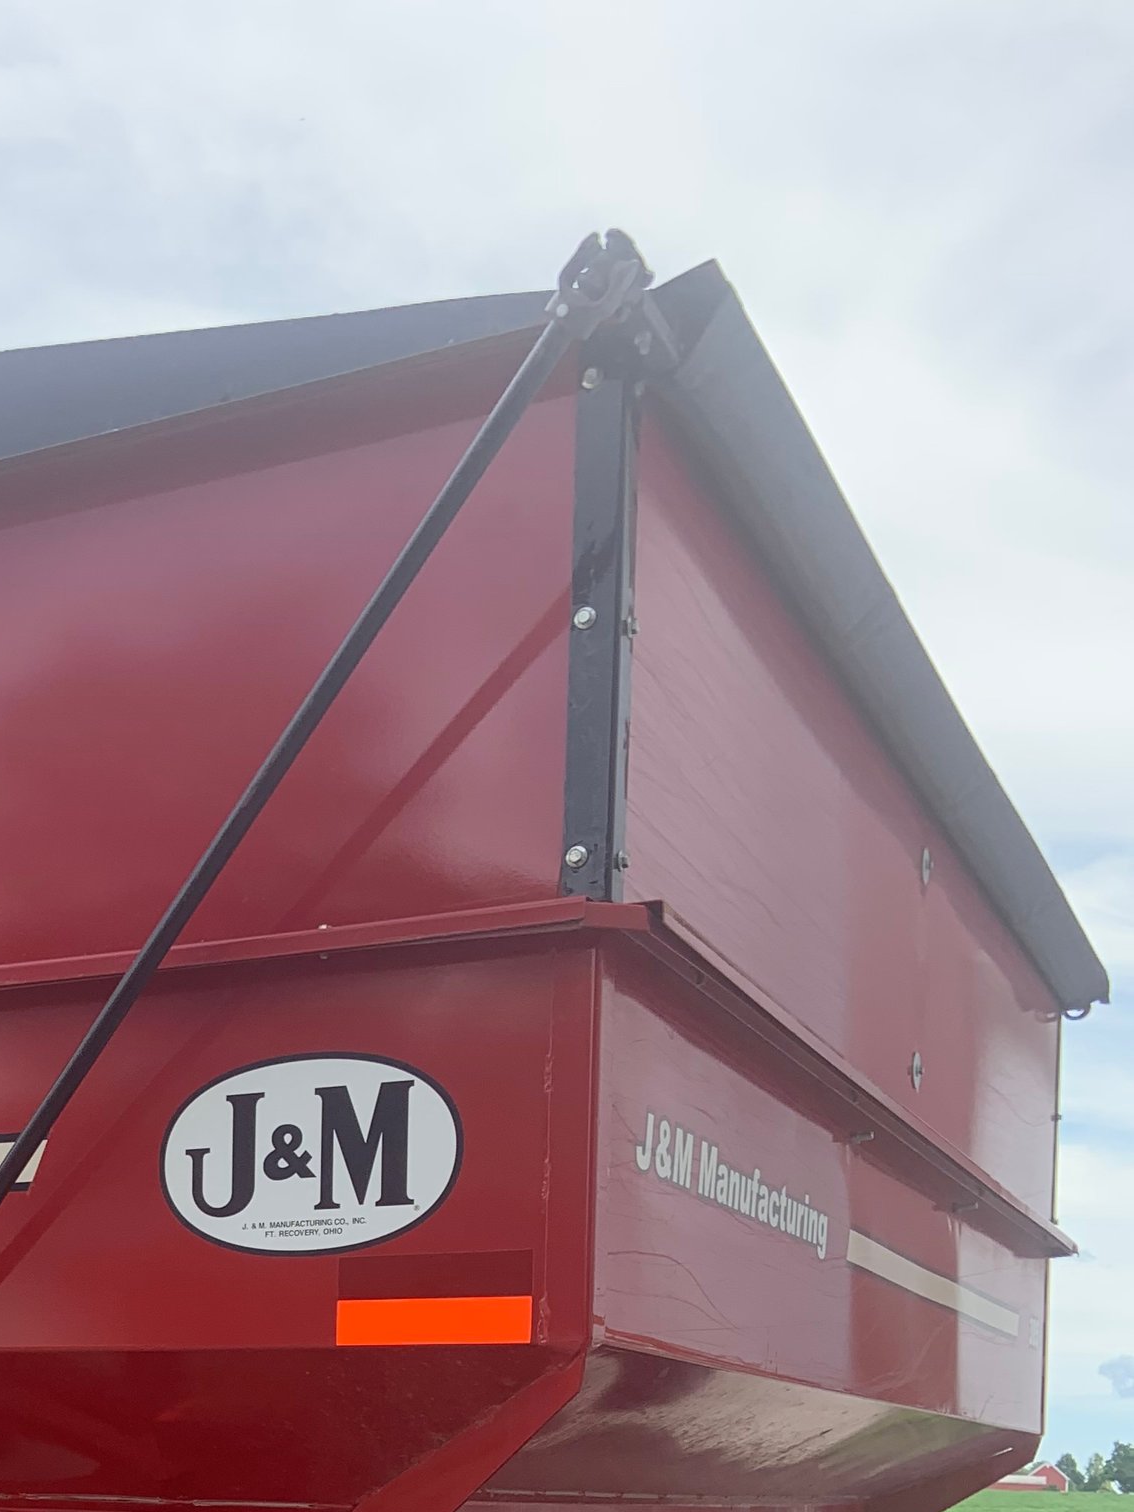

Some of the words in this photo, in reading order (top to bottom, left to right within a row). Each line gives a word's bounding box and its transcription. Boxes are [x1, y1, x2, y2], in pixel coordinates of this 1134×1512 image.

[185, 1079, 415, 1218] J&M
[636, 1112, 694, 1188] J&M
[698, 1141, 828, 1260] Manufacturing
[265, 1230, 277, 1238] FT.
[323, 1227, 343, 1235] OHIO
[269, 1219, 333, 1229] MANUFACTURING
[352, 1217, 367, 1225] INC.
